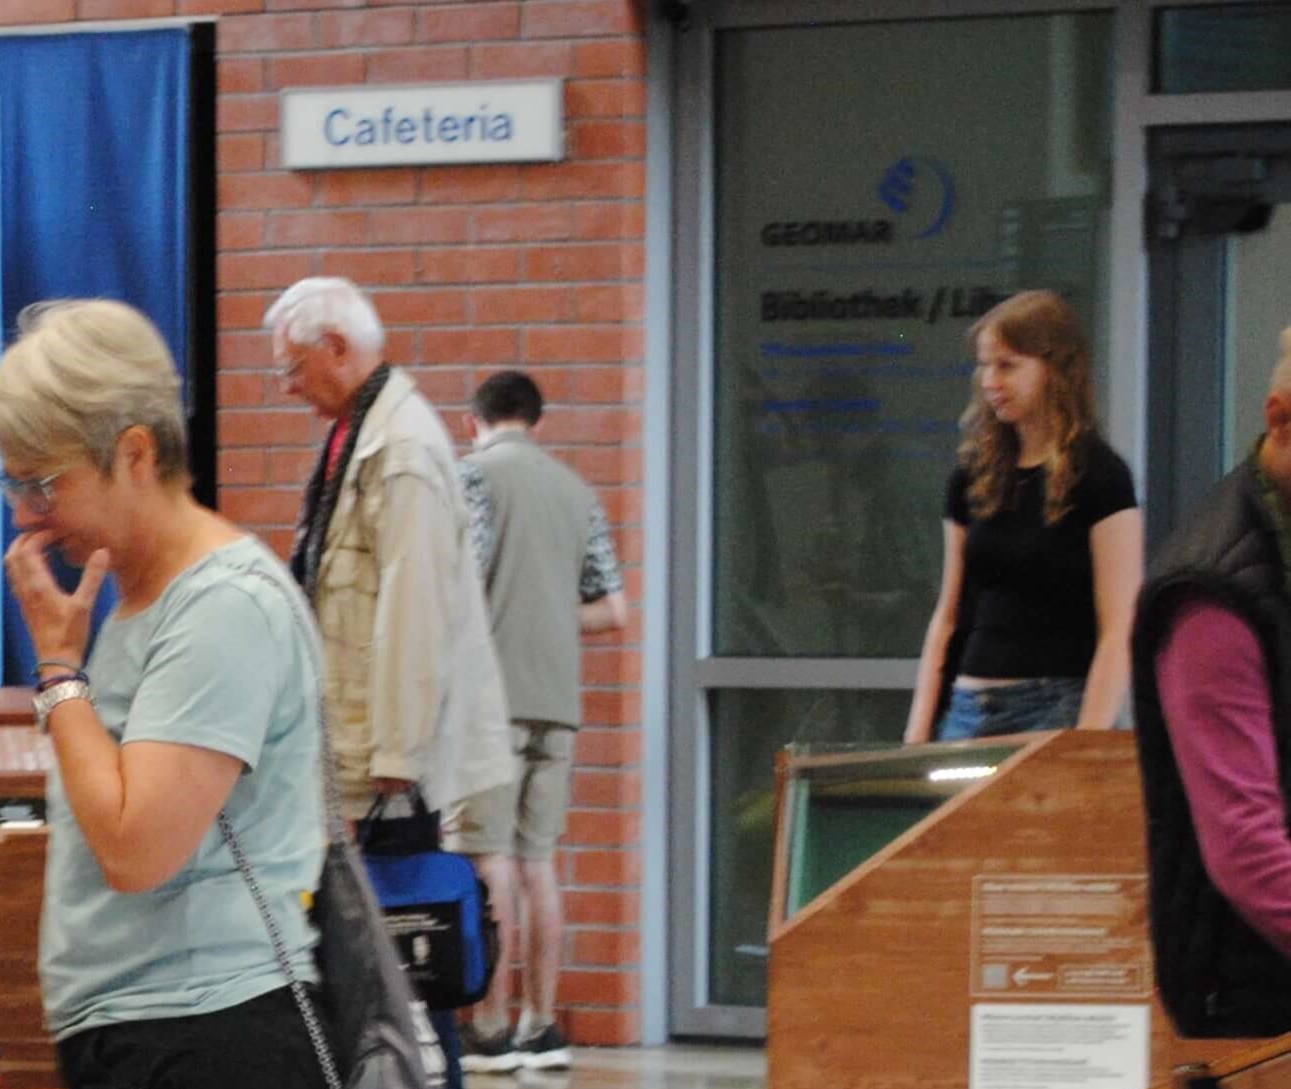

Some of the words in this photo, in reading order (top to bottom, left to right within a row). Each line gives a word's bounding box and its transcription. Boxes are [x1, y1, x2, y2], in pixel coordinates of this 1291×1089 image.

[323, 104, 513, 146] Cafeteria
[760, 219, 893, 246] GEOMAR
[760, 289, 920, 321] Bibliothek
